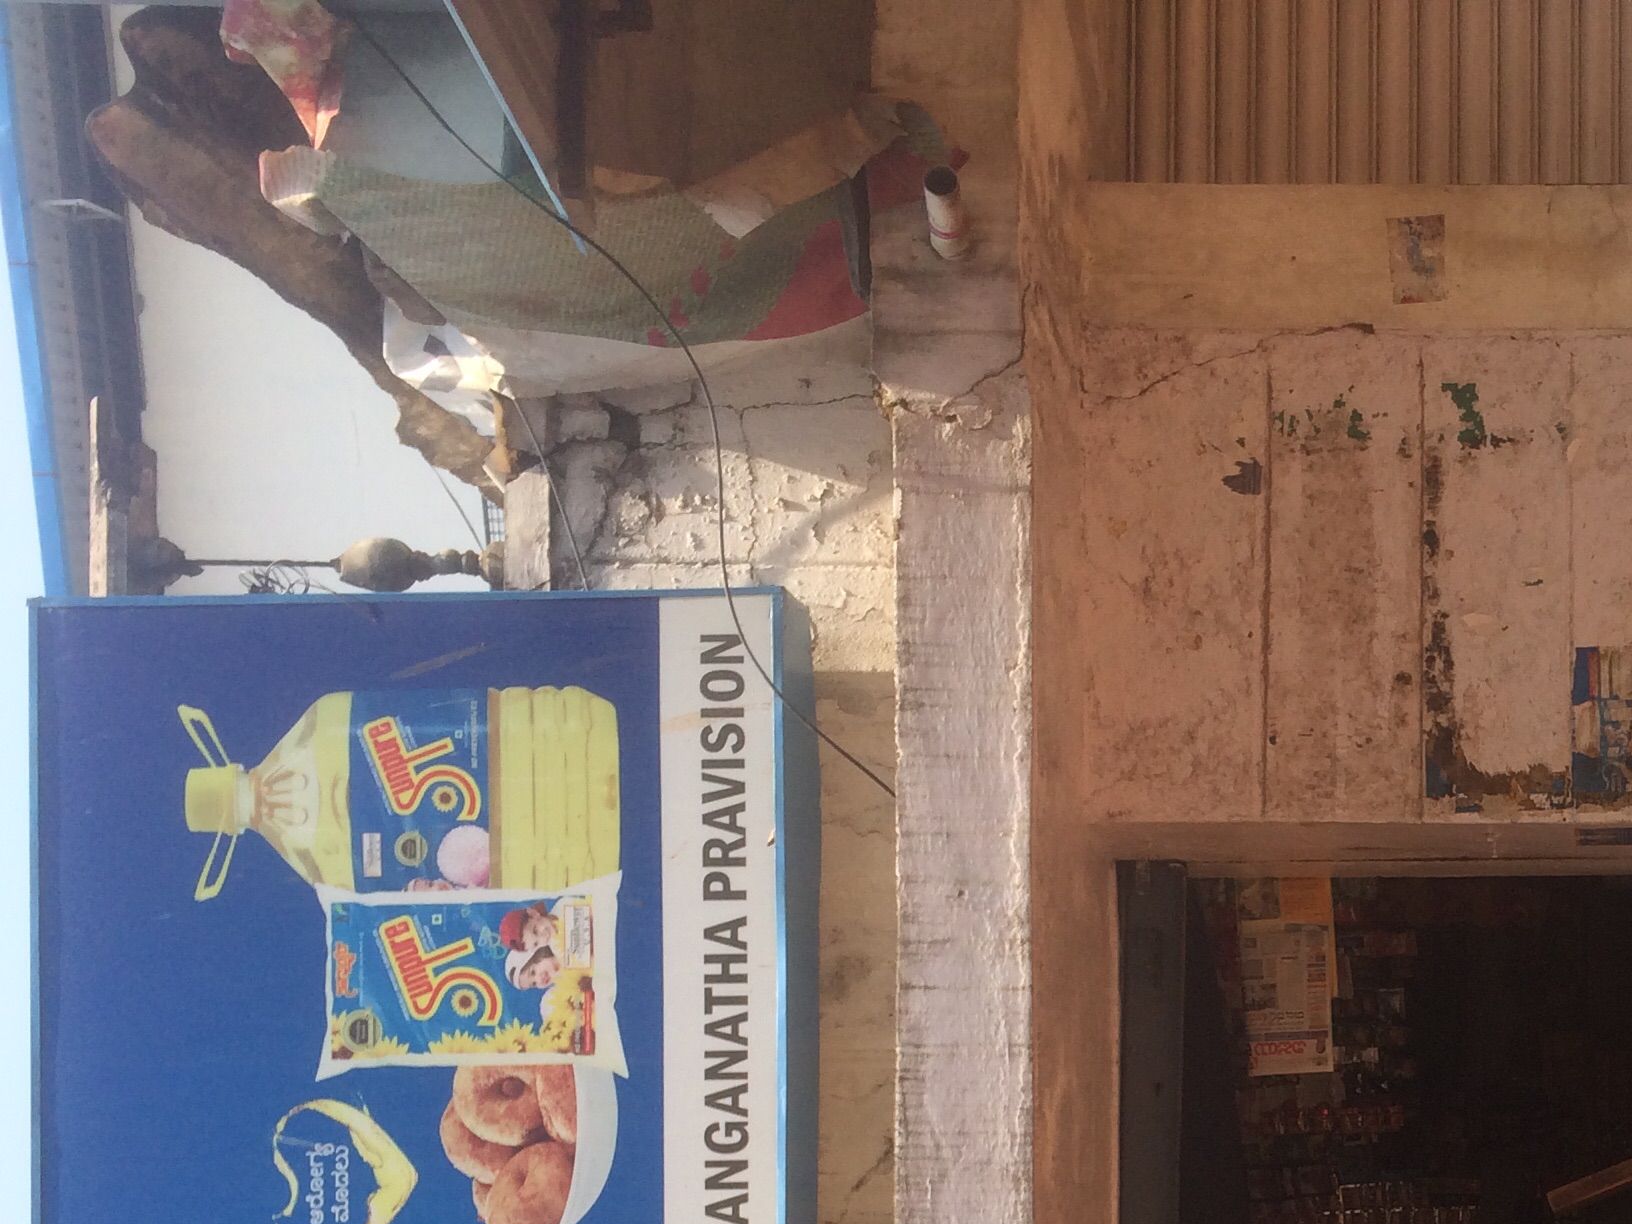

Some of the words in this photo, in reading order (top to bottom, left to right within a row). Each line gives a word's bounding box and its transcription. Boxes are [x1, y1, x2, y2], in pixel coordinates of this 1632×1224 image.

[700, 633, 746, 901] PRAVISION
[306, 1143, 336, 1224] ಆರೋಗ್ಯ
[328, 1143, 349, 1222] ಮೊದಲು
